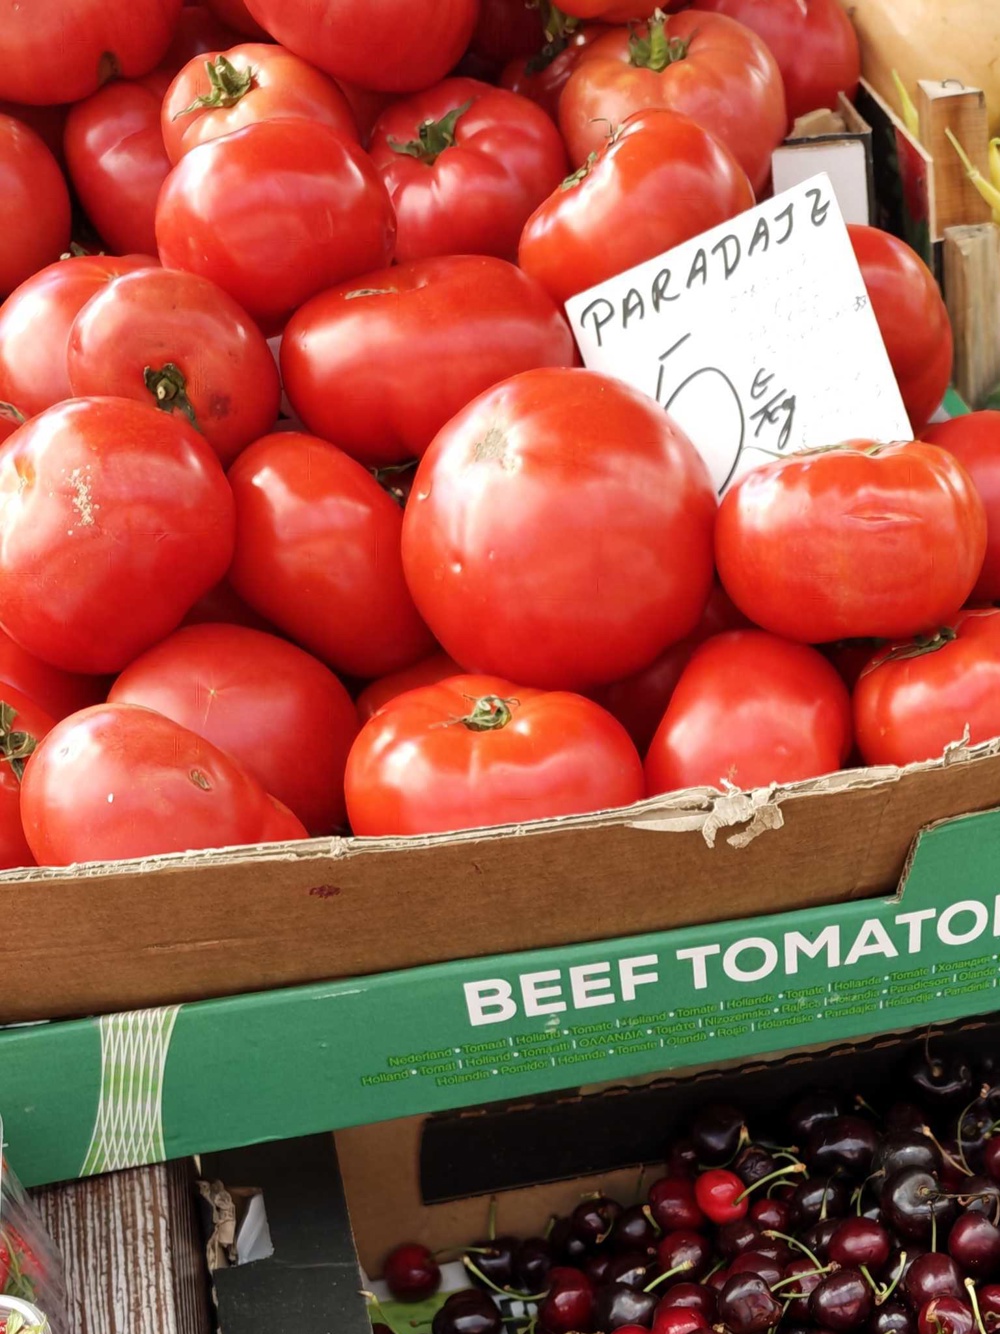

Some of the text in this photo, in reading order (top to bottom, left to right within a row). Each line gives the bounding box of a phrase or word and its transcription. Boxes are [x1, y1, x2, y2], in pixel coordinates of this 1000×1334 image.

[464, 955, 658, 1026] BEEF
[362, 1069, 410, 1086] Holland
[420, 1060, 457, 1076] Tomat
[465, 1050, 512, 1068] Holland
[890, 976, 951, 994] Paradicsom
[388, 1048, 453, 1067] Nederland
[464, 1038, 507, 1054] Tomaat
